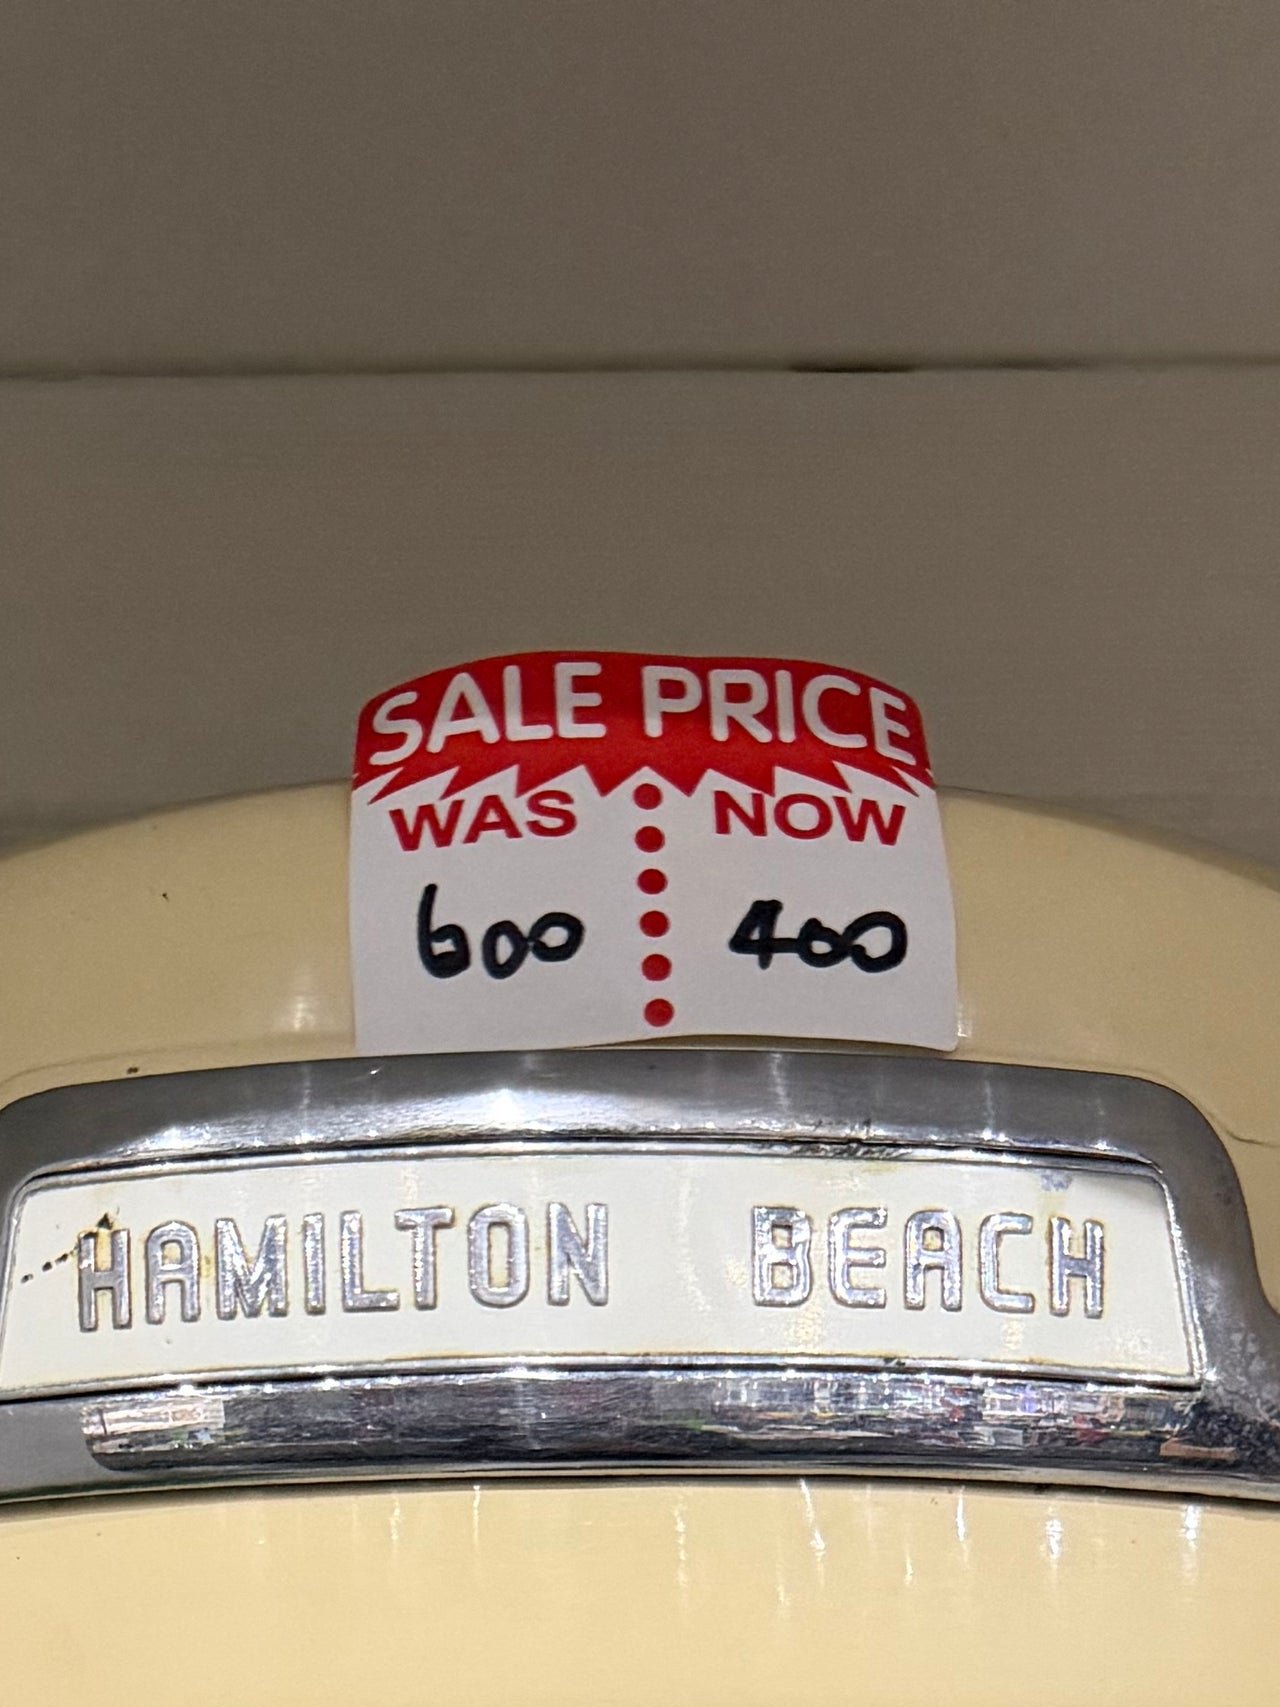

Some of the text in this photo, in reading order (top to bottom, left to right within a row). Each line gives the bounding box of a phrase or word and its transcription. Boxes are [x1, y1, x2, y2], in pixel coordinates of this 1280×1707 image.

[369, 661, 918, 766] SALE PRICE
[389, 789, 577, 851] WAS
[713, 790, 905, 846] NOW
[417, 883, 585, 978] 600
[728, 899, 908, 972] 400
[77, 1203, 1105, 1332] HAMILTON BEACH
